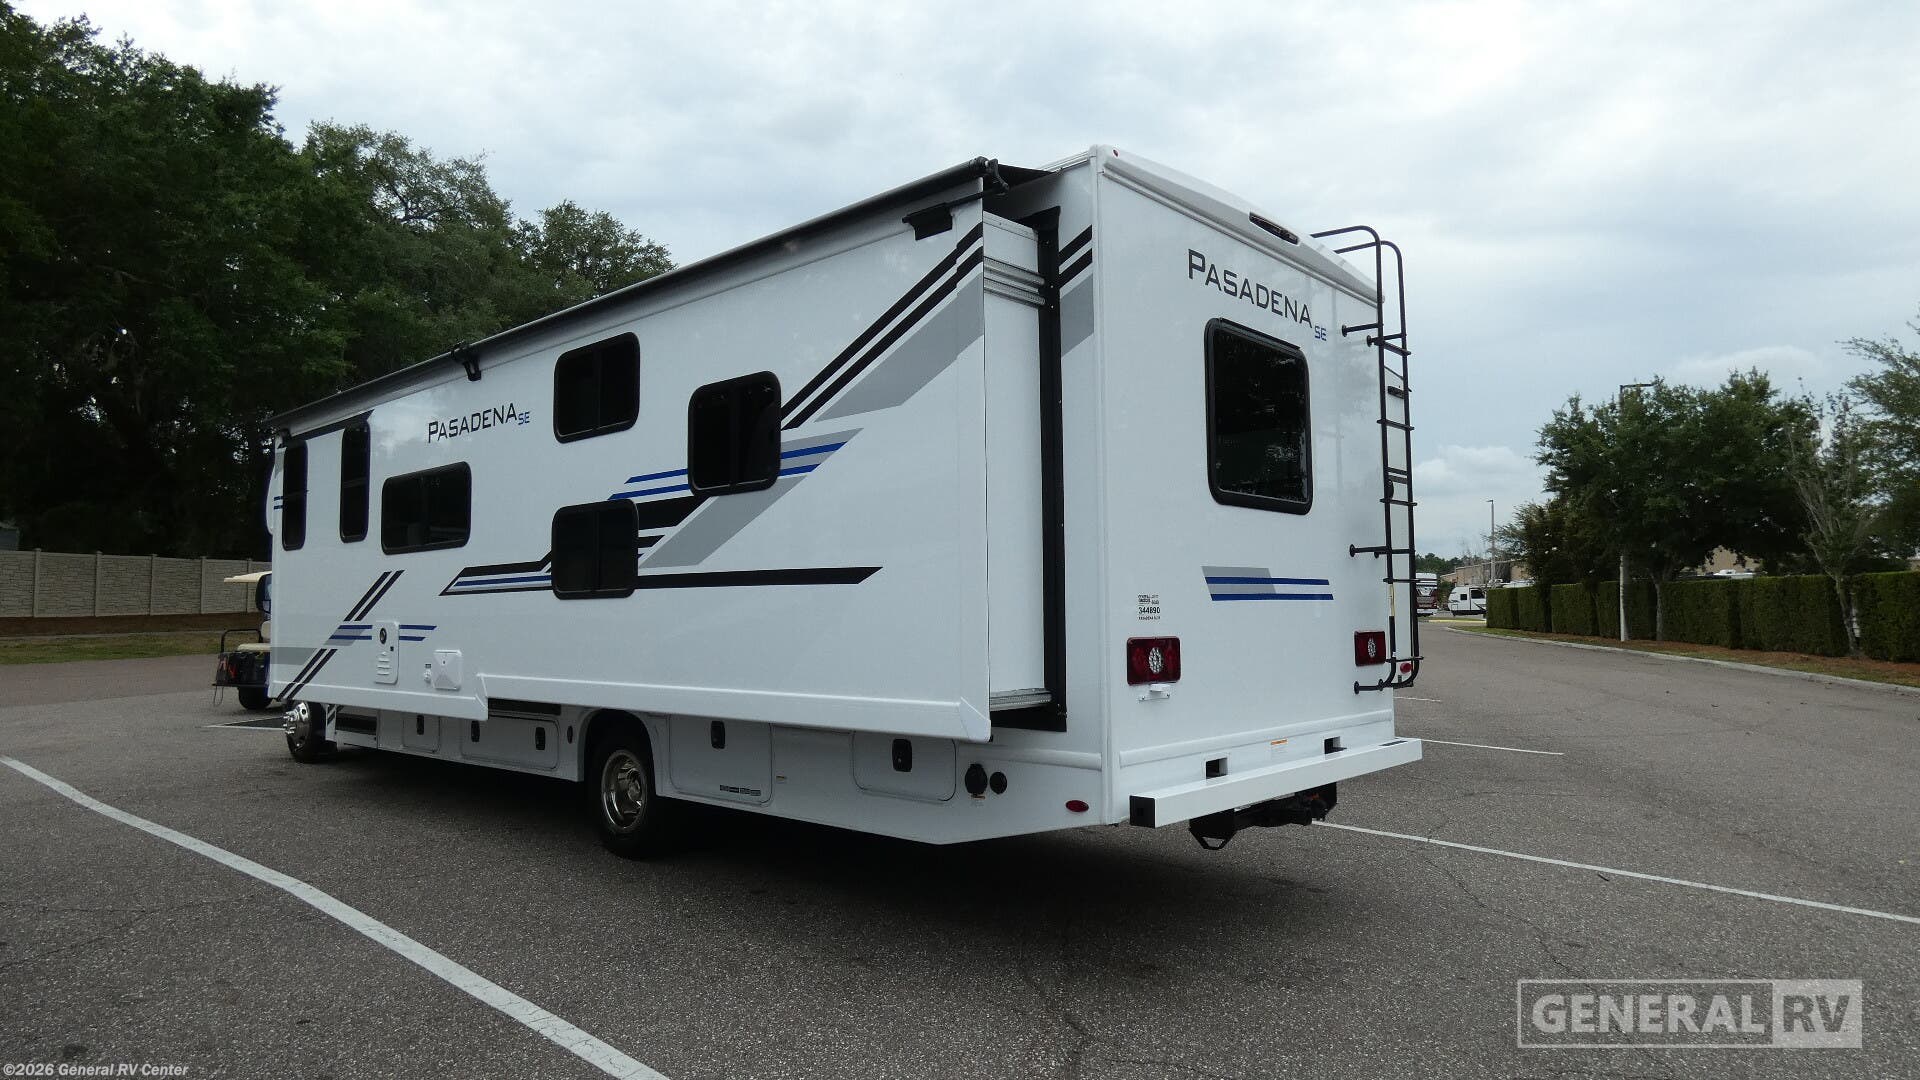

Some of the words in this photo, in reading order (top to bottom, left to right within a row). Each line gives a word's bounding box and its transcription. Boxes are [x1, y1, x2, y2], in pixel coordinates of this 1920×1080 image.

[1188, 248, 1313, 329] PASADENA
[1314, 325, 1327, 341] SE
[428, 402, 518, 444] PASADENA
[518, 411, 530, 425] SE
